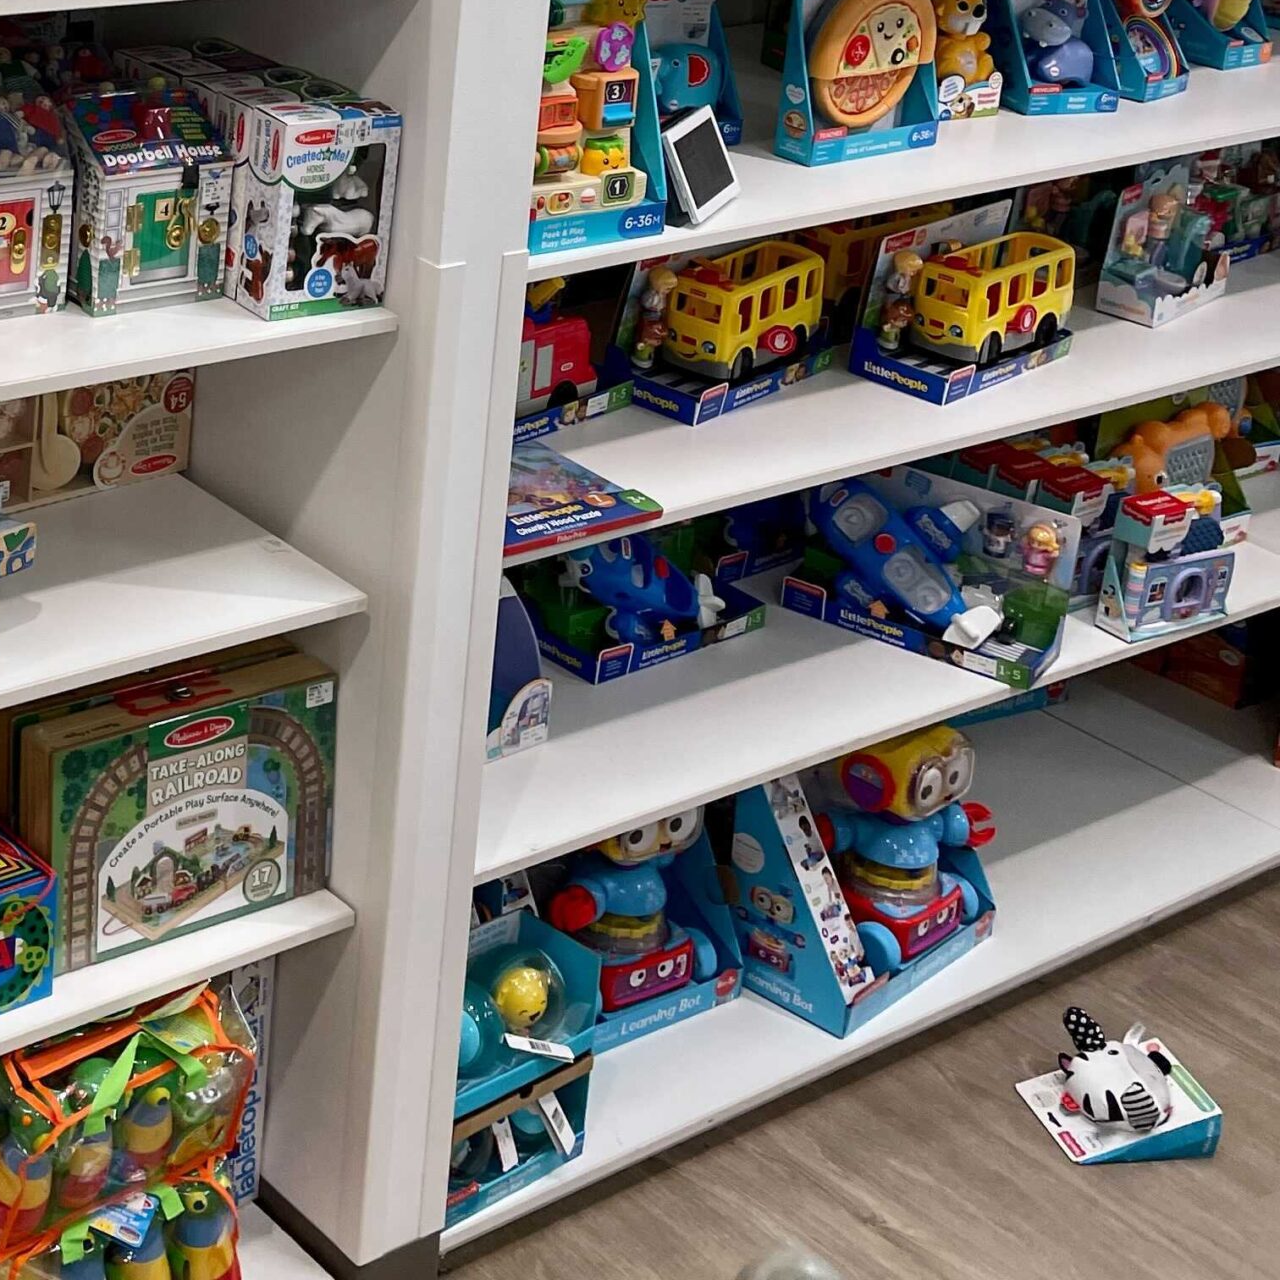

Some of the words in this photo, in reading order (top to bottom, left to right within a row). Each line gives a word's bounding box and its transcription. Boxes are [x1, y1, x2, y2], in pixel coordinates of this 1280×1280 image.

[611, 84, 621, 100] 3
[102, 145, 174, 168] Doorbell
[174, 144, 223, 159] House
[614, 179, 622, 195] 1
[541, 228, 560, 240] Peek
[568, 226, 586, 239] Play
[541, 238, 560, 250] Busy
[559, 234, 588, 247] Garden
[516, 520, 551, 537] Chunky
[551, 515, 574, 530] Wood
[574, 509, 603, 524] Puzzle
[151, 743, 246, 782] TAKE-ALONG
[150, 766, 242, 807] RAILROAD
[109, 834, 138, 868] Create
[143, 805, 184, 832] Portable
[184, 798, 204, 813] Play
[206, 793, 239, 805] Surface
[240, 793, 280, 818] Anywhere!
[251, 867, 272, 887] 17
[621, 1004, 678, 1036] Learning
[678, 994, 702, 1013] Bot
[791, 996, 815, 1015] Bot
[235, 1089, 262, 1207] Tabletop
